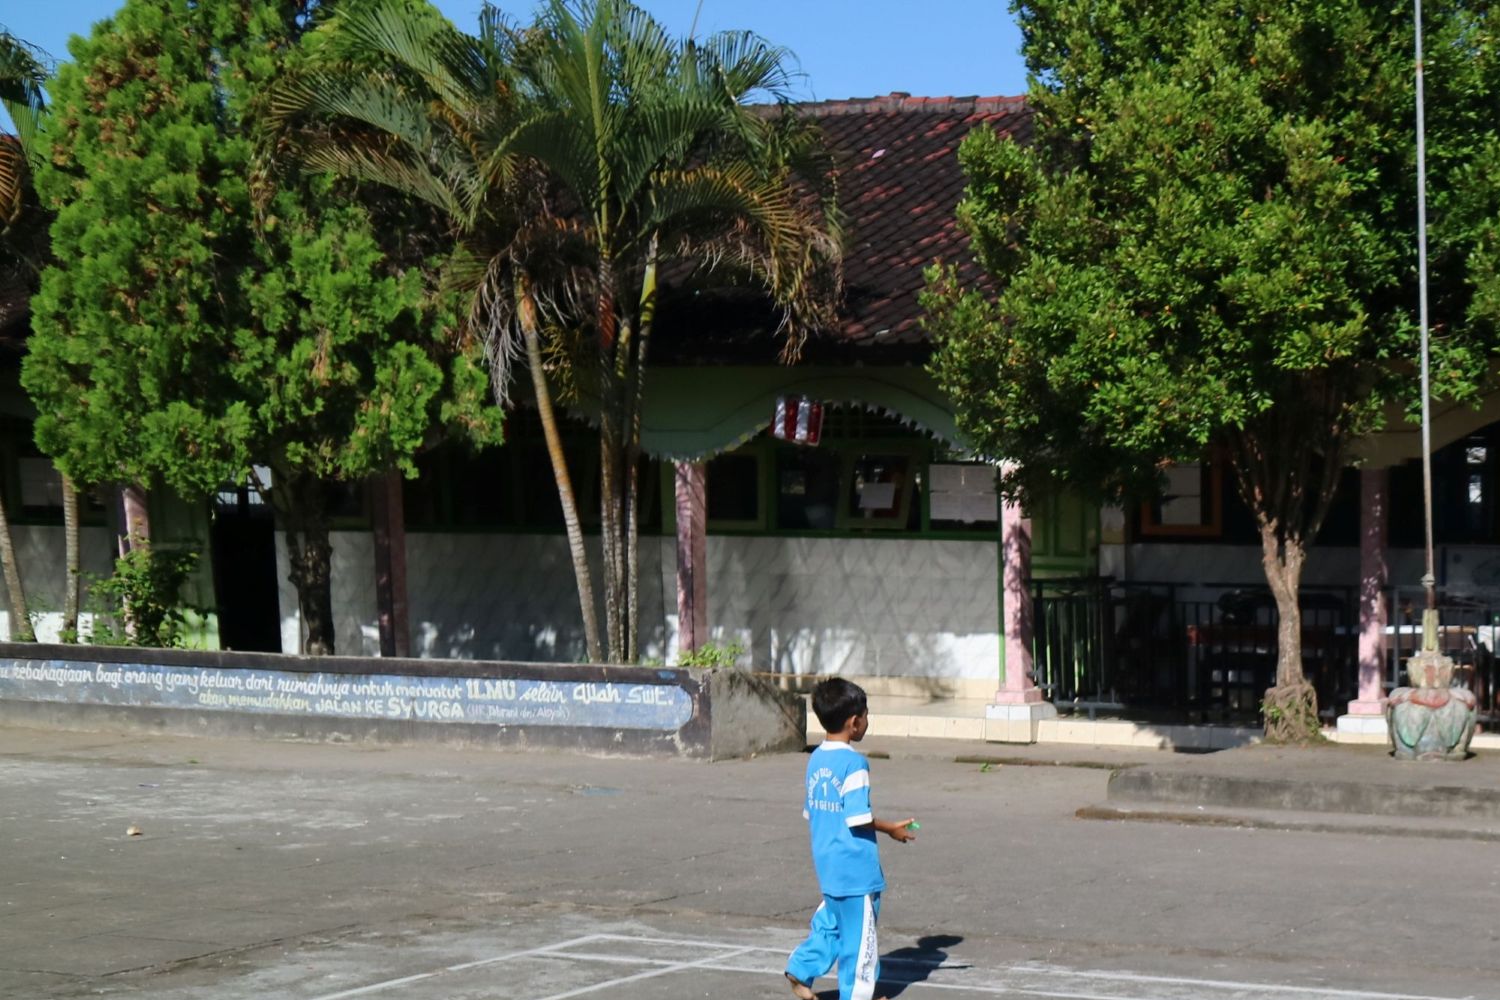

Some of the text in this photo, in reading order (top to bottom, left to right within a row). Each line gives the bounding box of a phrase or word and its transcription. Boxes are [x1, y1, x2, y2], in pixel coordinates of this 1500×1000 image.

[13, 661, 93, 687] kebahagiaan
[96, 664, 121, 689] bagi
[124, 671, 163, 691] orang
[165, 672, 199, 694] yang
[200, 671, 244, 691] keluar
[246, 673, 273, 692] dari
[276, 672, 349, 700] rumahnya
[352, 680, 394, 696] untuk
[395, 683, 463, 699] menuntut
[466, 680, 516, 700] ILMU
[519, 682, 567, 704] selain
[199, 688, 229, 708] akan
[228, 691, 312, 712] memudahkan
[315, 699, 361, 713] JALAN
[365, 699, 384, 714] KE
[387, 697, 465, 719] SYURGA
[821, 781, 827, 798] 1
